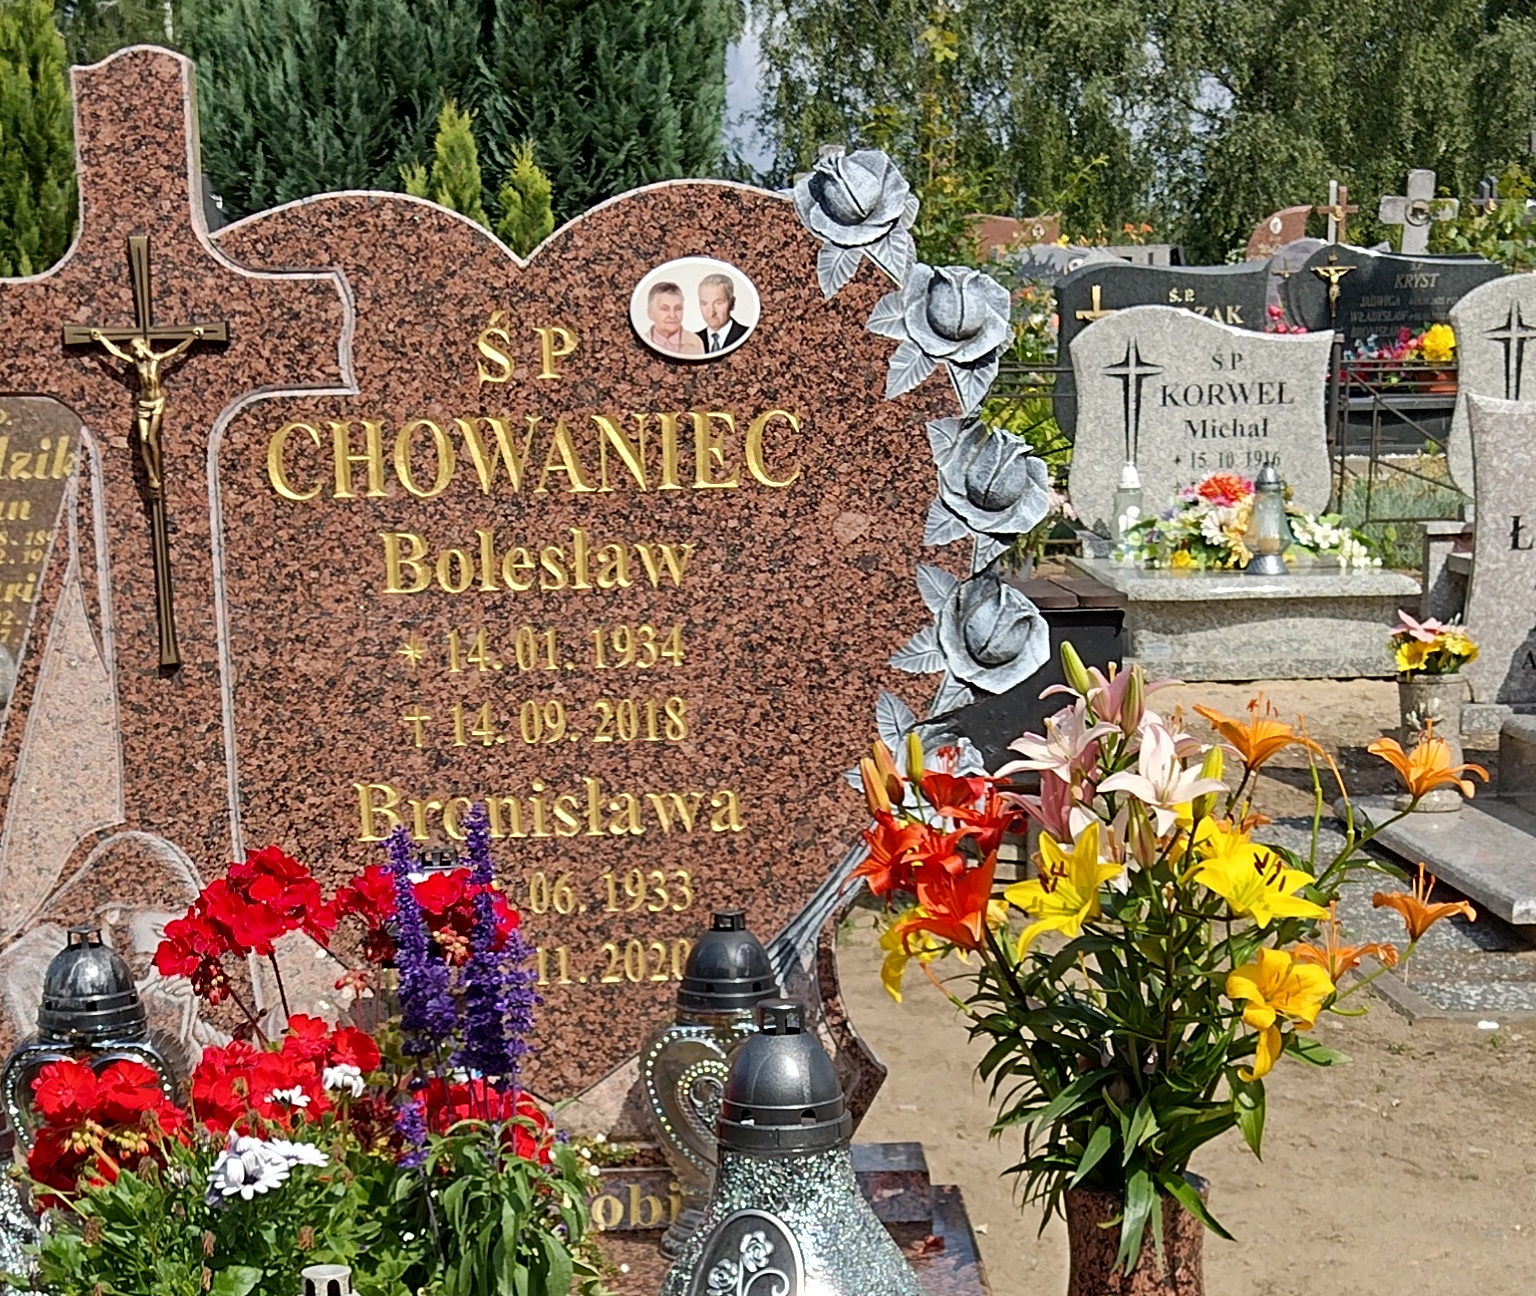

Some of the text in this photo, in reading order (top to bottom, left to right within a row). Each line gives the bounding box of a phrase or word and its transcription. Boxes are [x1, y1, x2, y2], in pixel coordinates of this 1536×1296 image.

[1393, 272, 1441, 290] KRYST
[1160, 381, 1296, 408] KORWEL
[266, 409, 802, 501] CHOWANIEC
[378, 526, 698, 594] Bolesław
[593, 623, 685, 669] 1934
[593, 695, 690, 742] 2018
[352, 775, 747, 843] Bronisława
[603, 868, 694, 913] 1933
